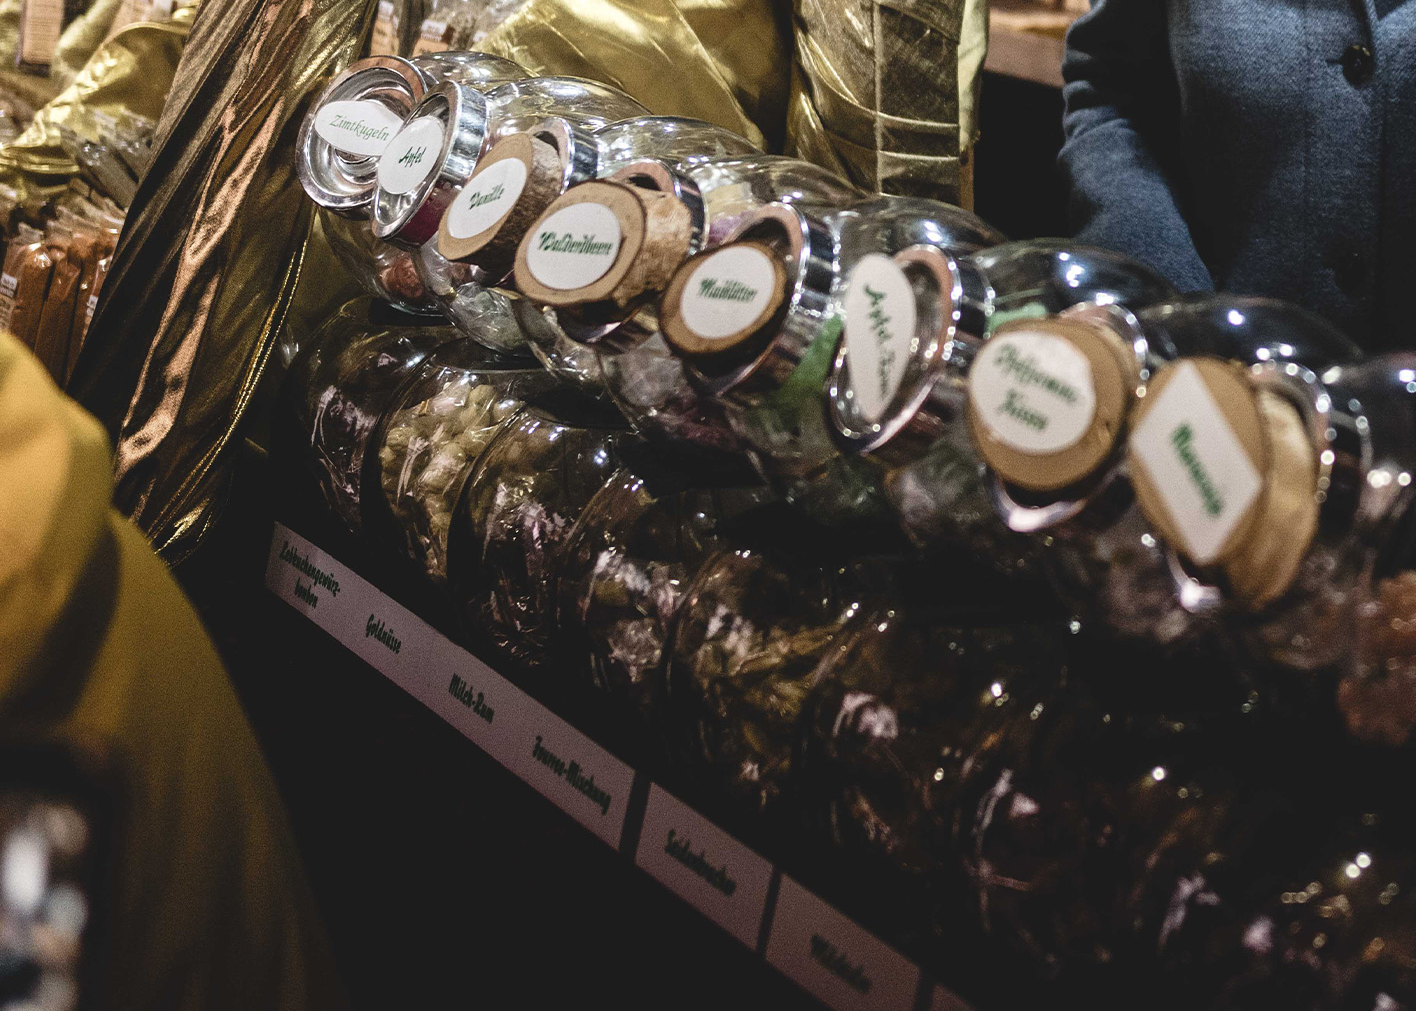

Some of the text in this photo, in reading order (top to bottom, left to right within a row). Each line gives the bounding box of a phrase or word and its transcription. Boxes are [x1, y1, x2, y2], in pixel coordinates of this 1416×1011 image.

[329, 114, 390, 142] Zimtkugeln
[398, 146, 427, 168] Apfel
[365, 613, 402, 655] Goldnüsse
